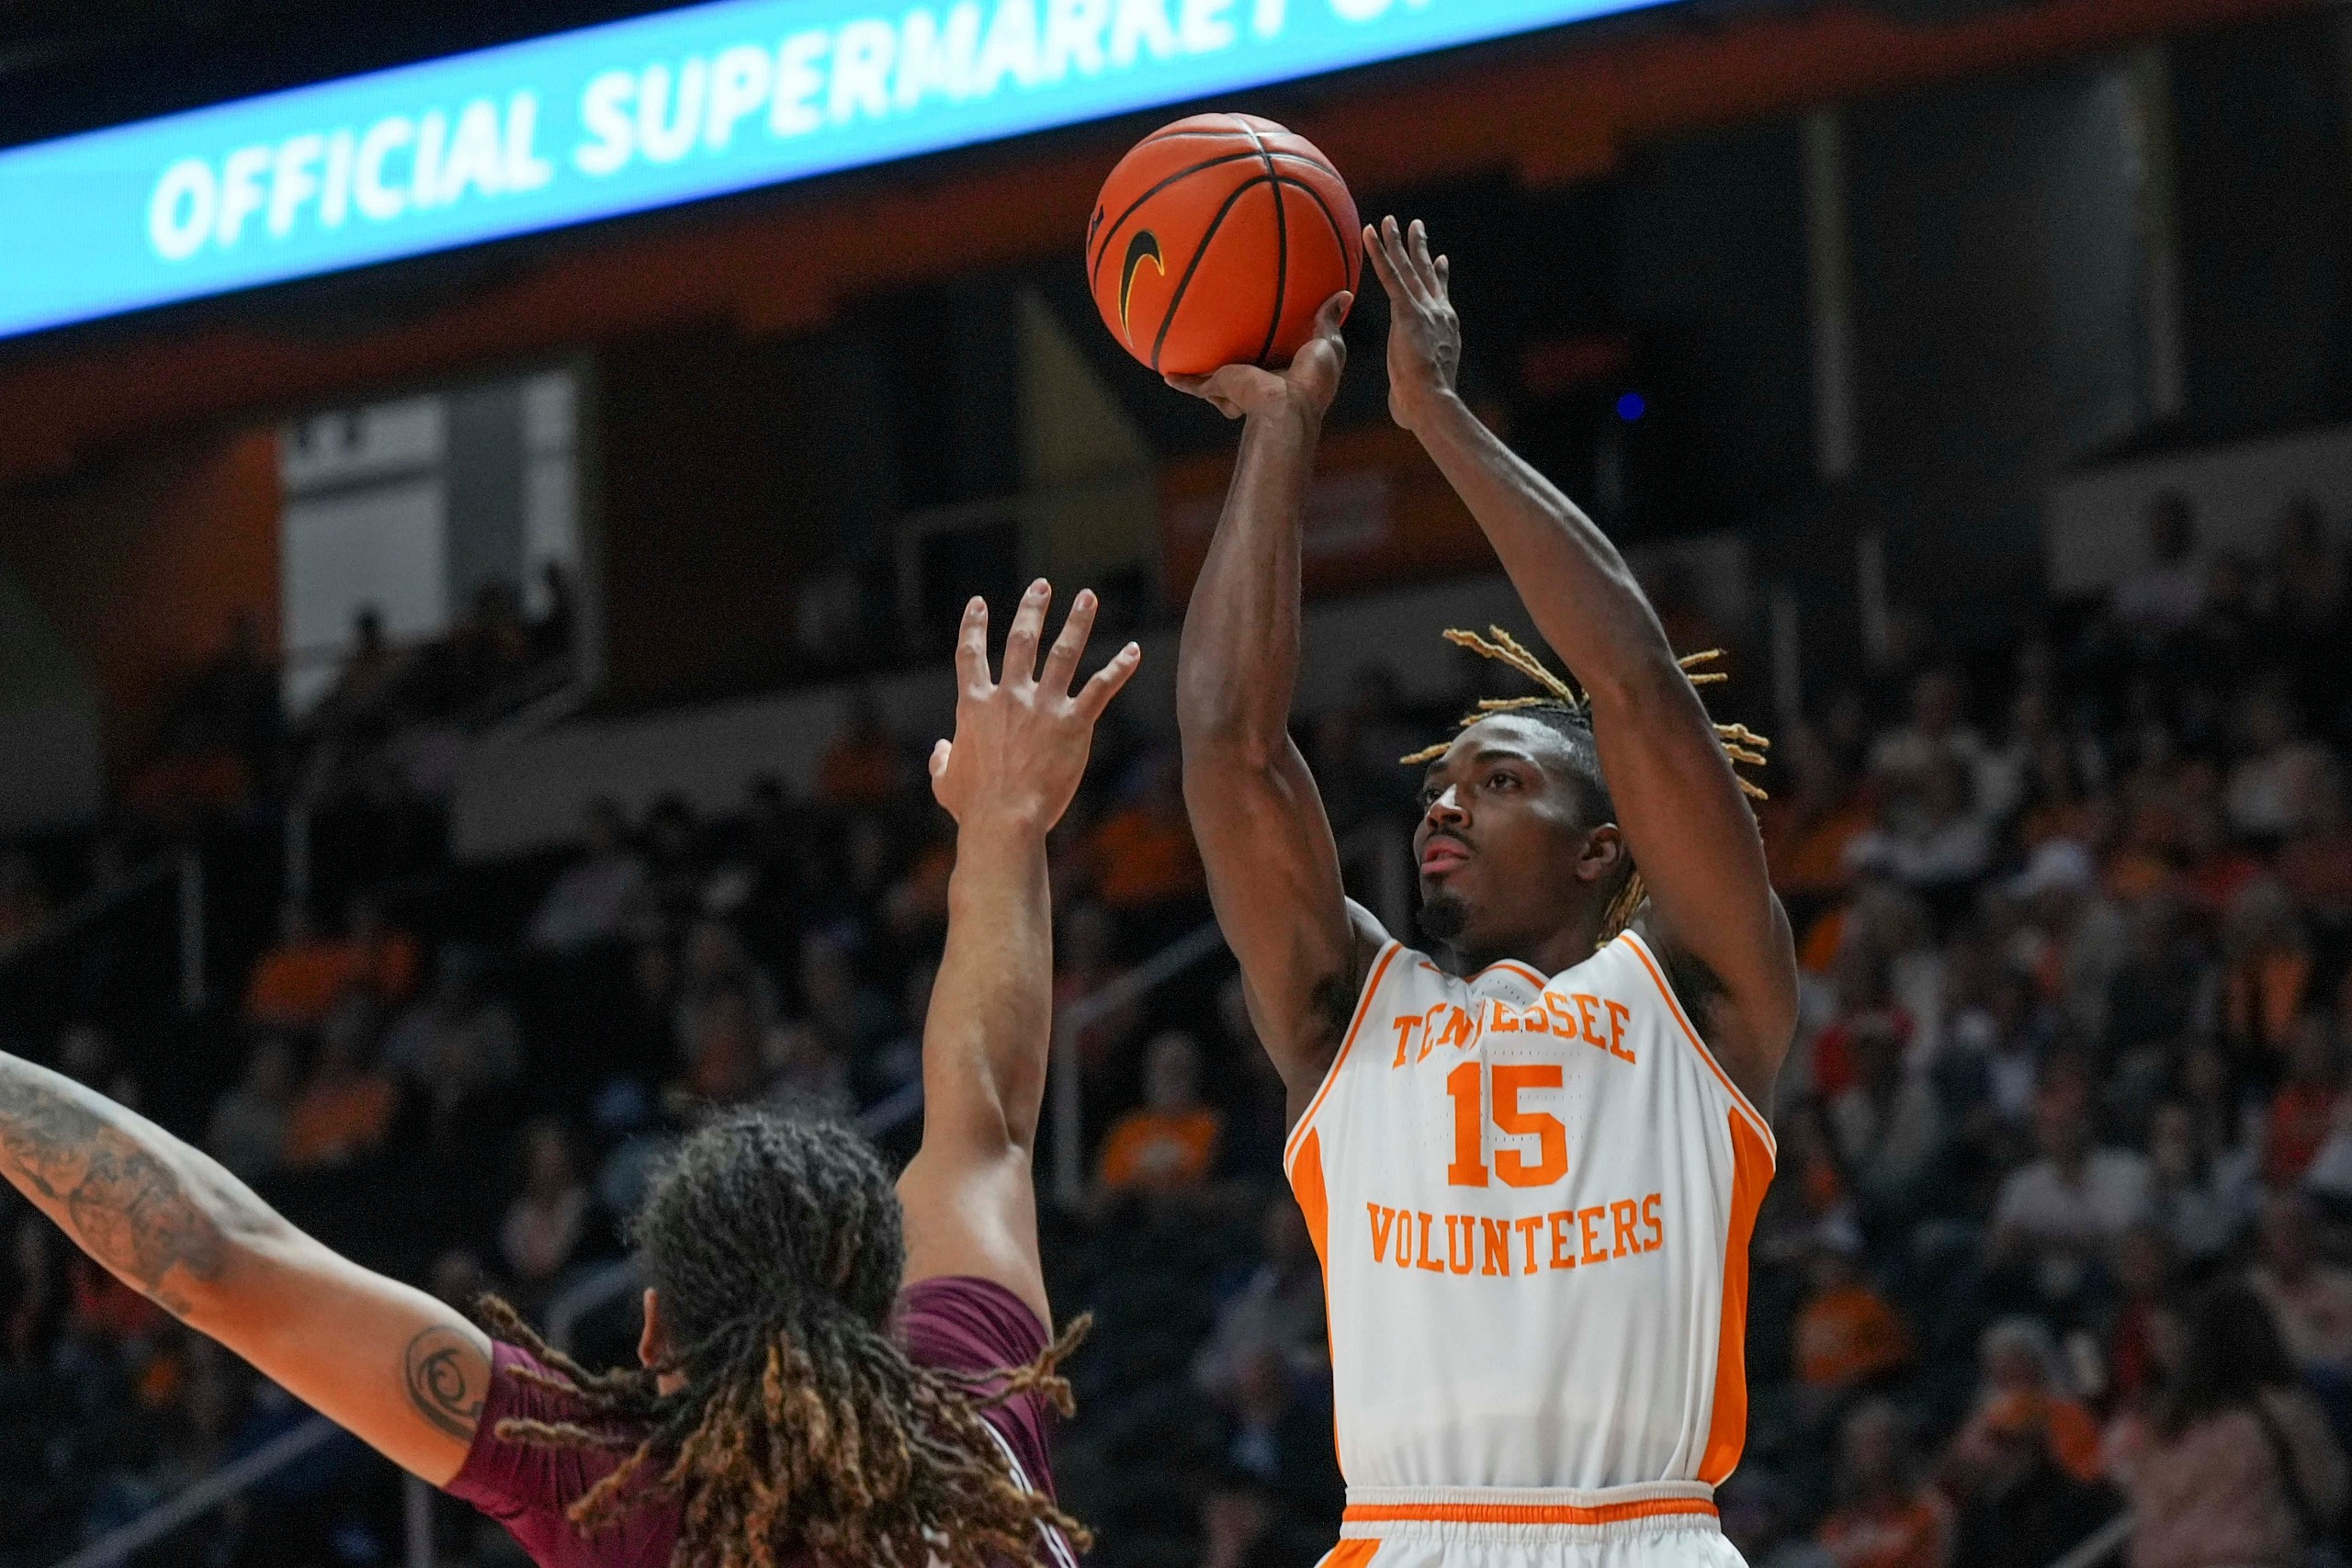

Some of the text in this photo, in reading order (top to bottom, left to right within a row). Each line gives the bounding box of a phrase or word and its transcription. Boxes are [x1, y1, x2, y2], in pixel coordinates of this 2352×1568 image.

[149, 92, 551, 260] OFFICIAL
[1447, 1062, 1568, 1188] 15
[1367, 1193, 1664, 1277] VOLUNTEERS
